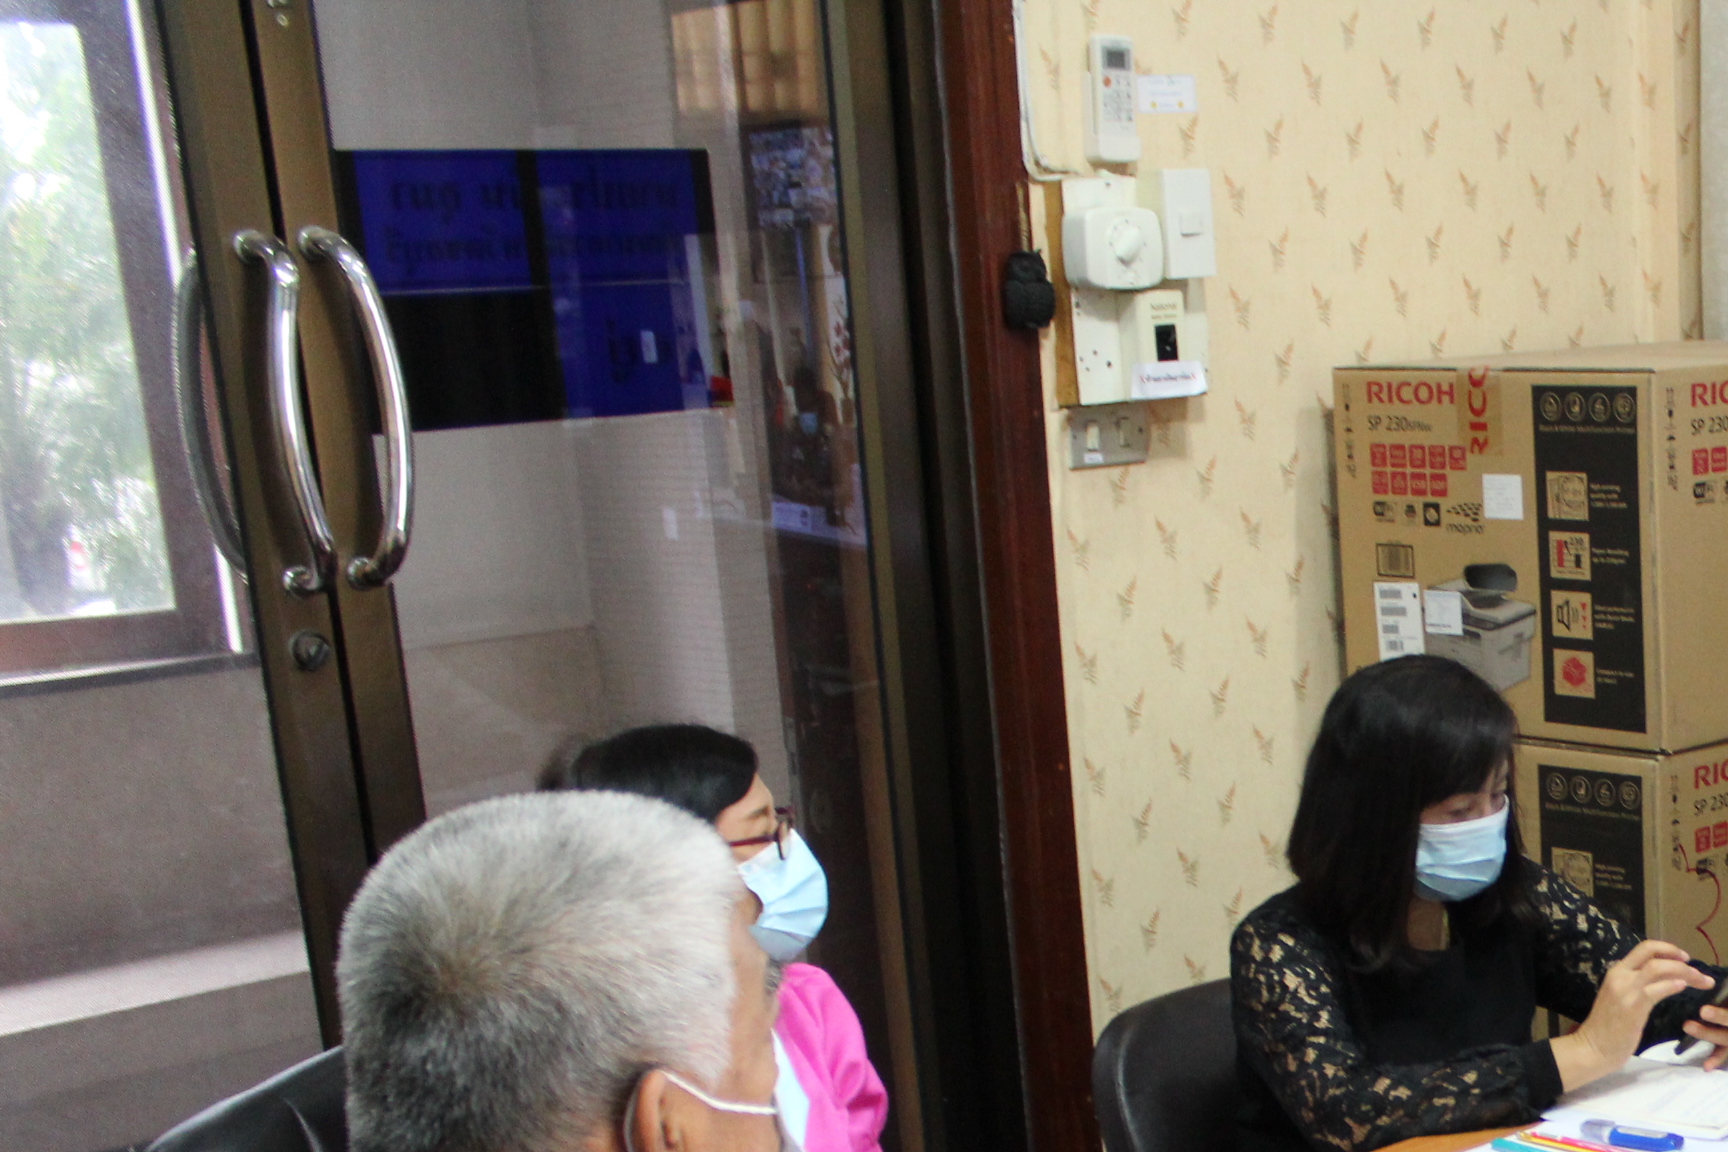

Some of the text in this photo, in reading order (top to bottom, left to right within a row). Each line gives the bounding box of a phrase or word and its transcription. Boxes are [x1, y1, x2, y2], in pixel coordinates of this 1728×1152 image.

[1366, 380, 1456, 405] RICOH
[1367, 414, 1382, 432] SP
[1690, 418, 1705, 436] SP
